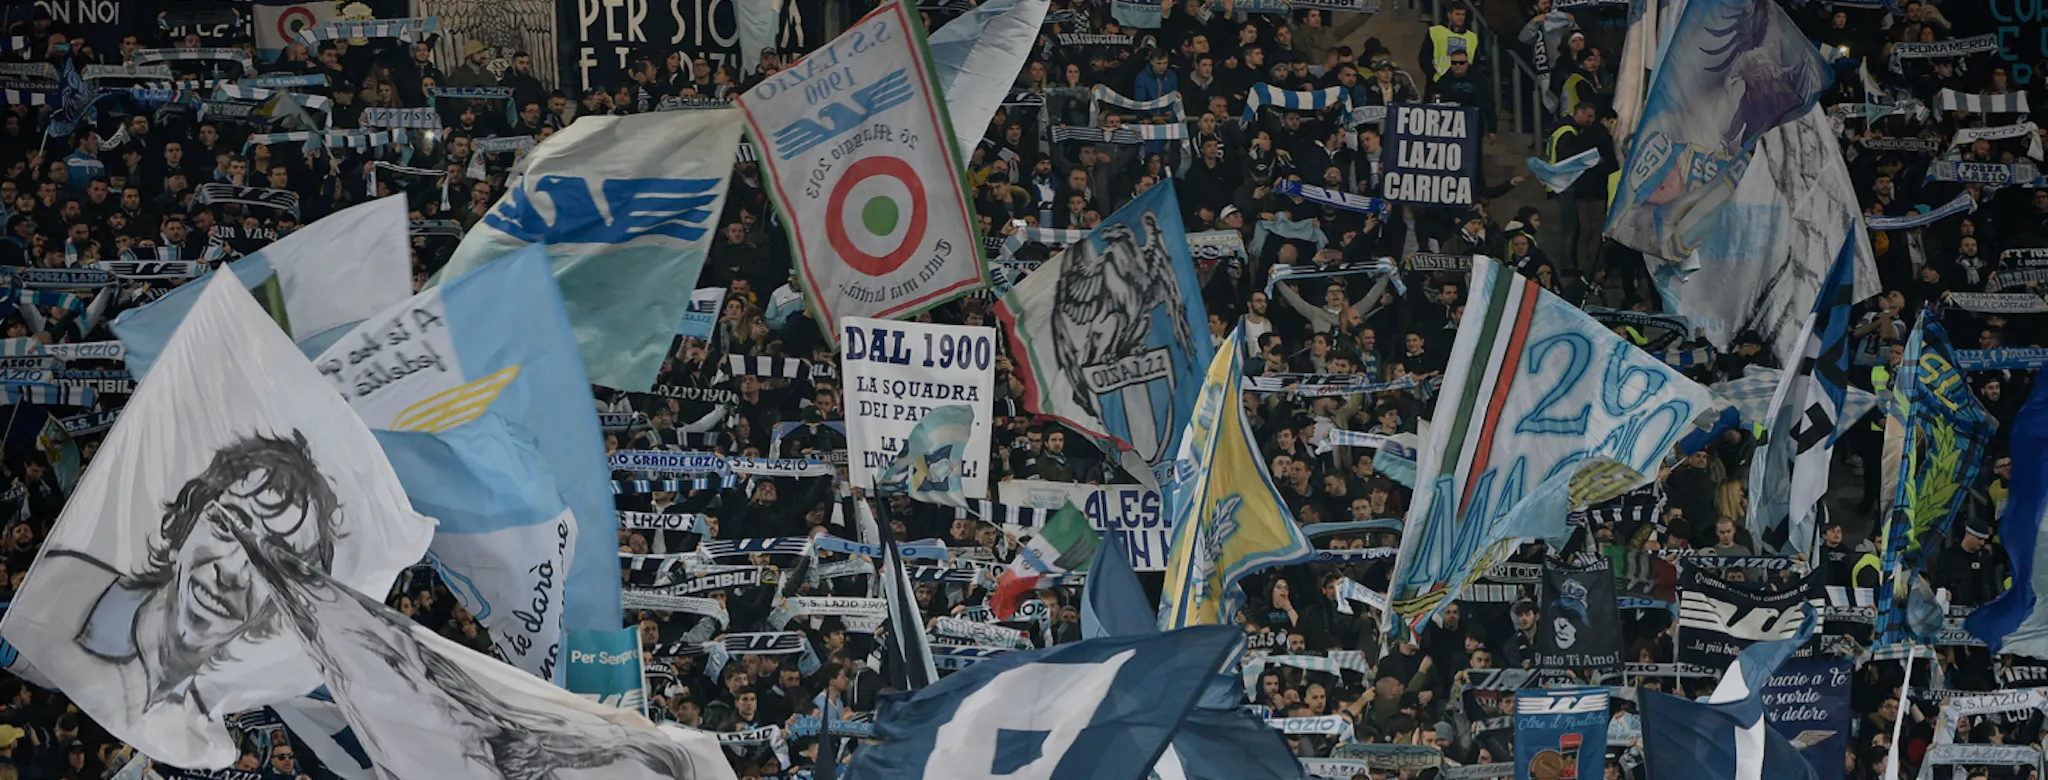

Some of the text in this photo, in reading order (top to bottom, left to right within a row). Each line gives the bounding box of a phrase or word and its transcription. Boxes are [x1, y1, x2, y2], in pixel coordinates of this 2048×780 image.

[1396, 106, 1467, 139] FORZA
[1397, 140, 1462, 171] LAZIO
[1383, 171, 1473, 205] CARICA
[1415, 256, 1457, 270] MISTER
[846, 326, 991, 371] DAL 1900
[857, 376, 979, 402] LA SQUADRA
[1515, 332, 1668, 436] 26
[860, 400, 889, 418] DEI
[881, 437, 897, 452] LA
[634, 455, 686, 467] GRANDE
[690, 455, 725, 470] LAZIO
[766, 459, 809, 472] LAZIO
[633, 514, 683, 529] LAZIO
[824, 600, 859, 610] LAZIO
[571, 650, 596, 664] Per
[1566, 653, 1580, 667] Ti
[1582, 650, 1621, 667] Amo!
[1761, 671, 1810, 687] raccio
[1781, 705, 1828, 722] dolore
